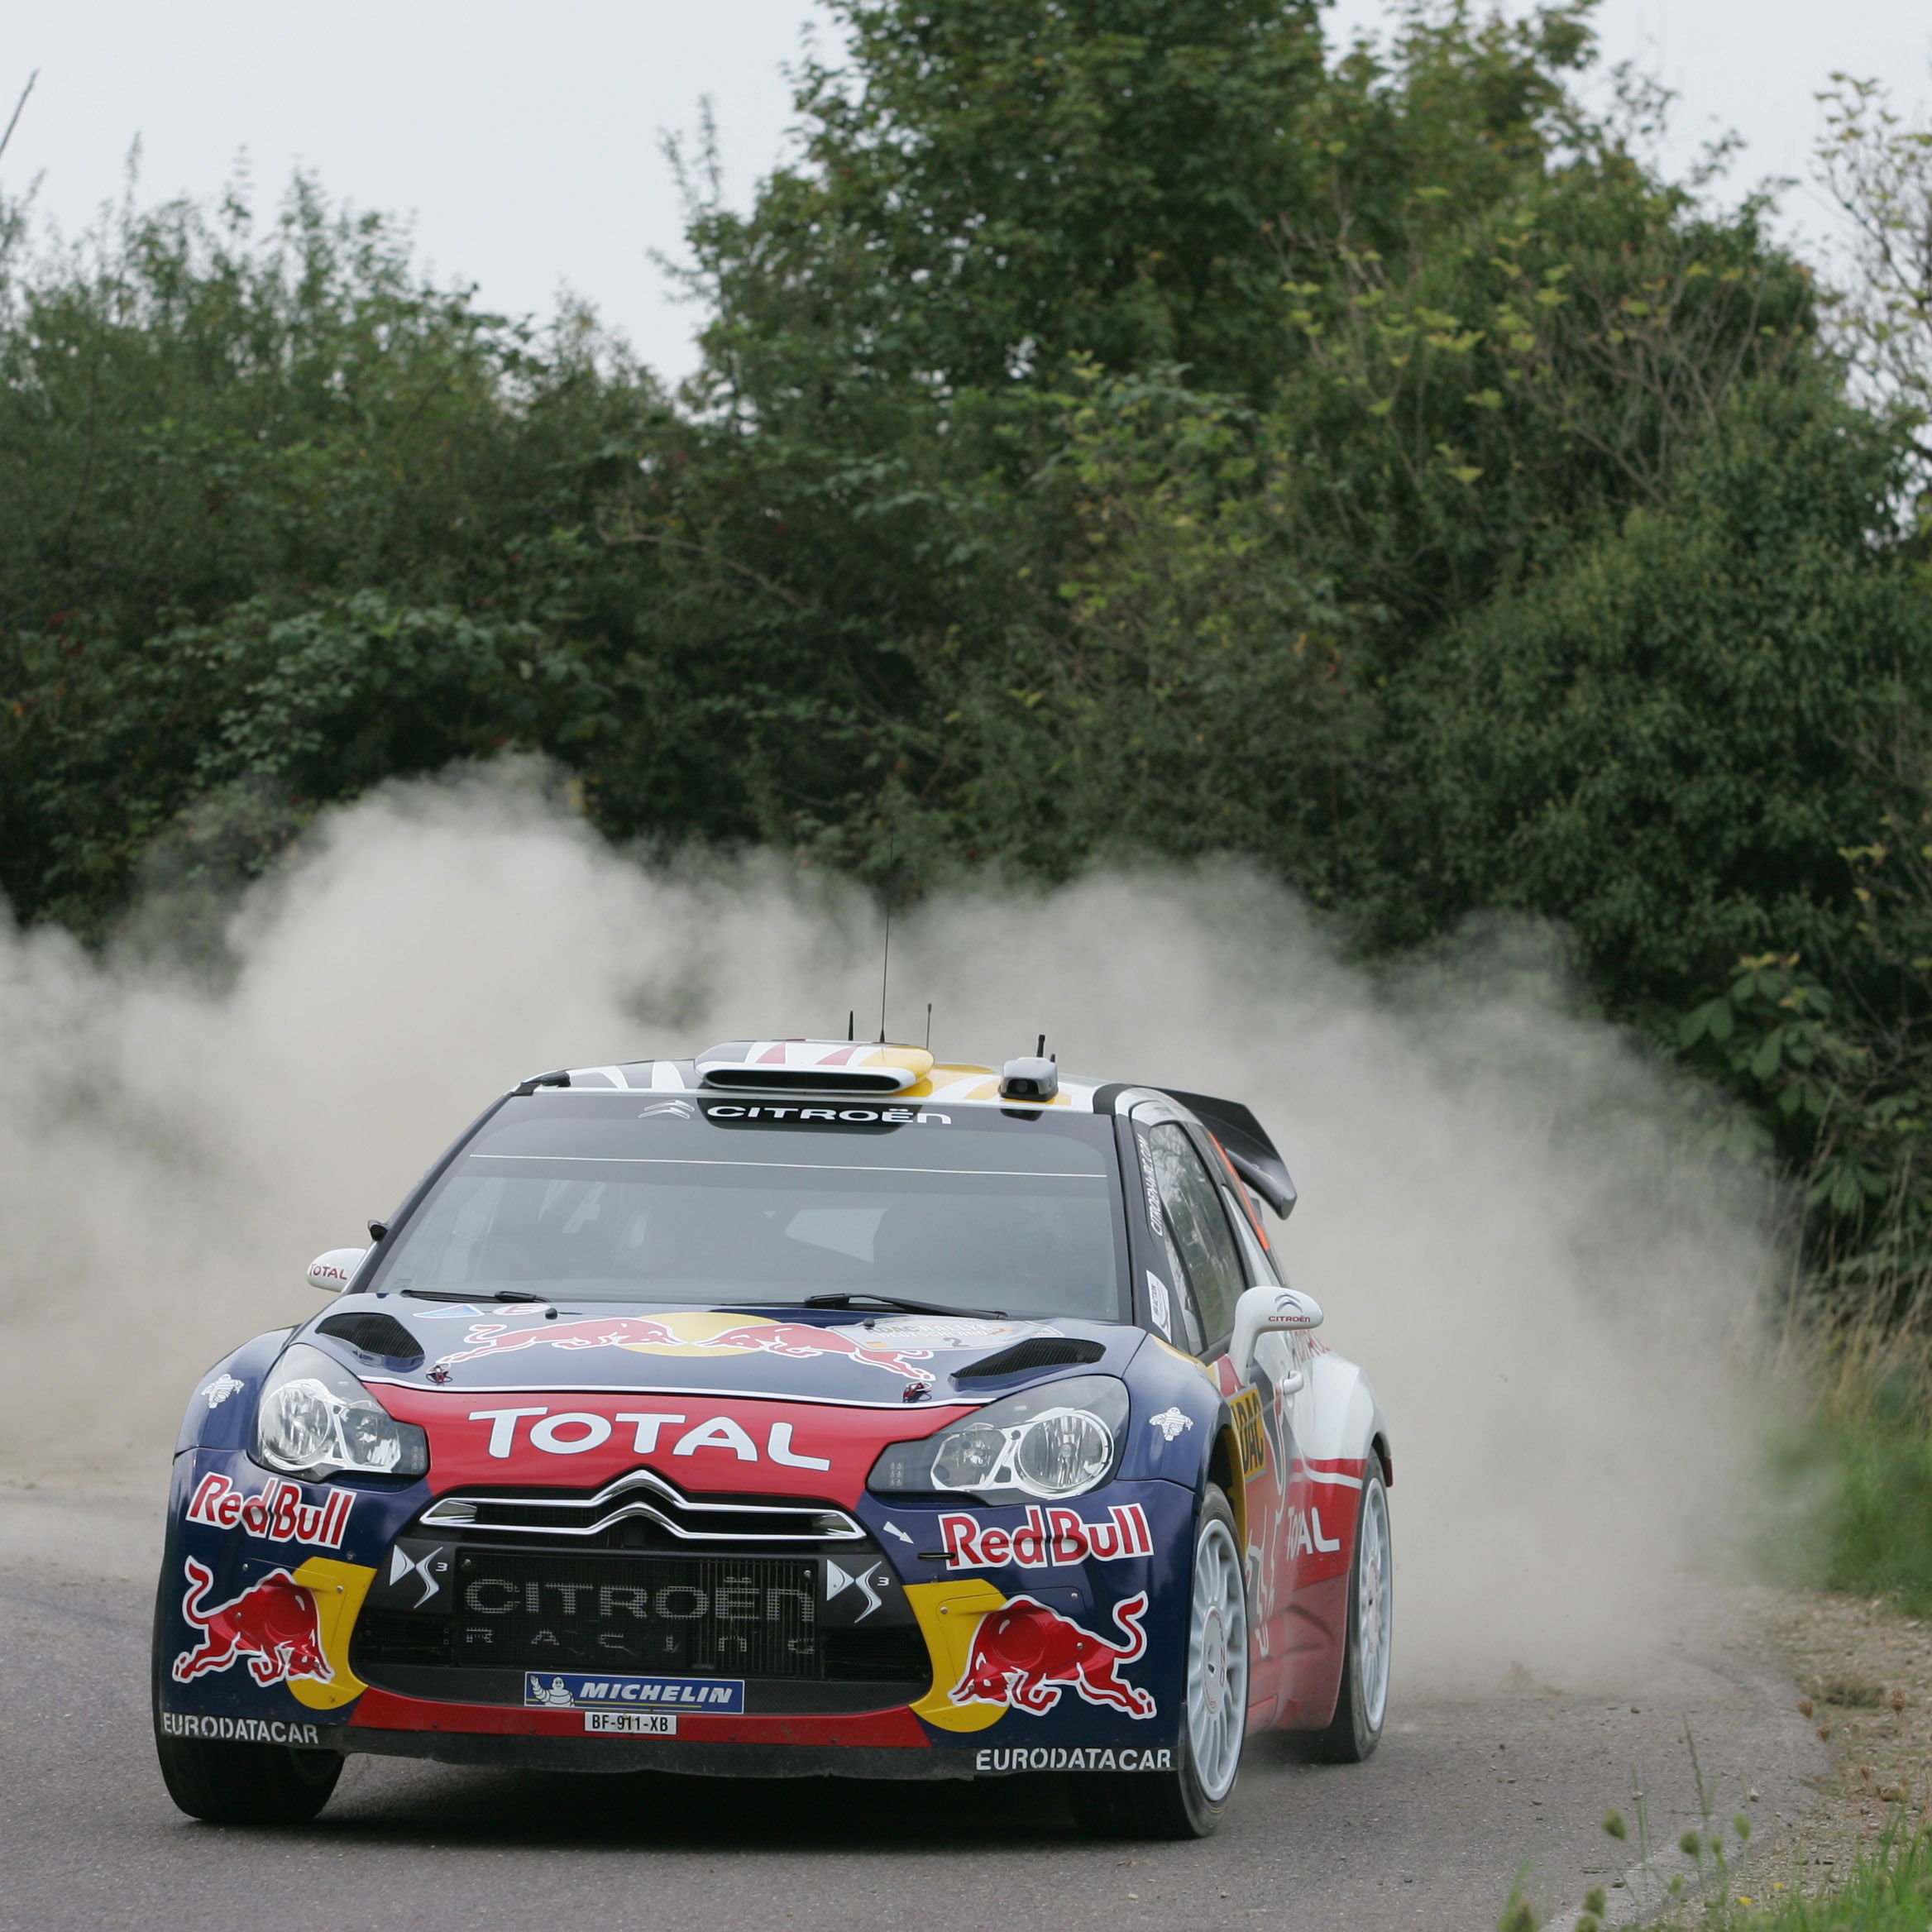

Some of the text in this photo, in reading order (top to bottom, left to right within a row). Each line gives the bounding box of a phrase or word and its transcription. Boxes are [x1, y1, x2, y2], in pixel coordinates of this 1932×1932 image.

[707, 1106, 952, 1125] CITROËN
[308, 1262, 347, 1281] TOTAL
[1268, 1314, 1311, 1323] CITROËN
[942, 1337, 971, 1348] 2
[468, 1406, 830, 1471] TOTAL
[465, 1577, 815, 1622] CITROËN
[579, 1681, 733, 1704] MICHELIN
[162, 1711, 319, 1745] EURODATACAR
[591, 1714, 669, 1733] BF-911-XB
[975, 1747, 1171, 1771] EURODATACAR
